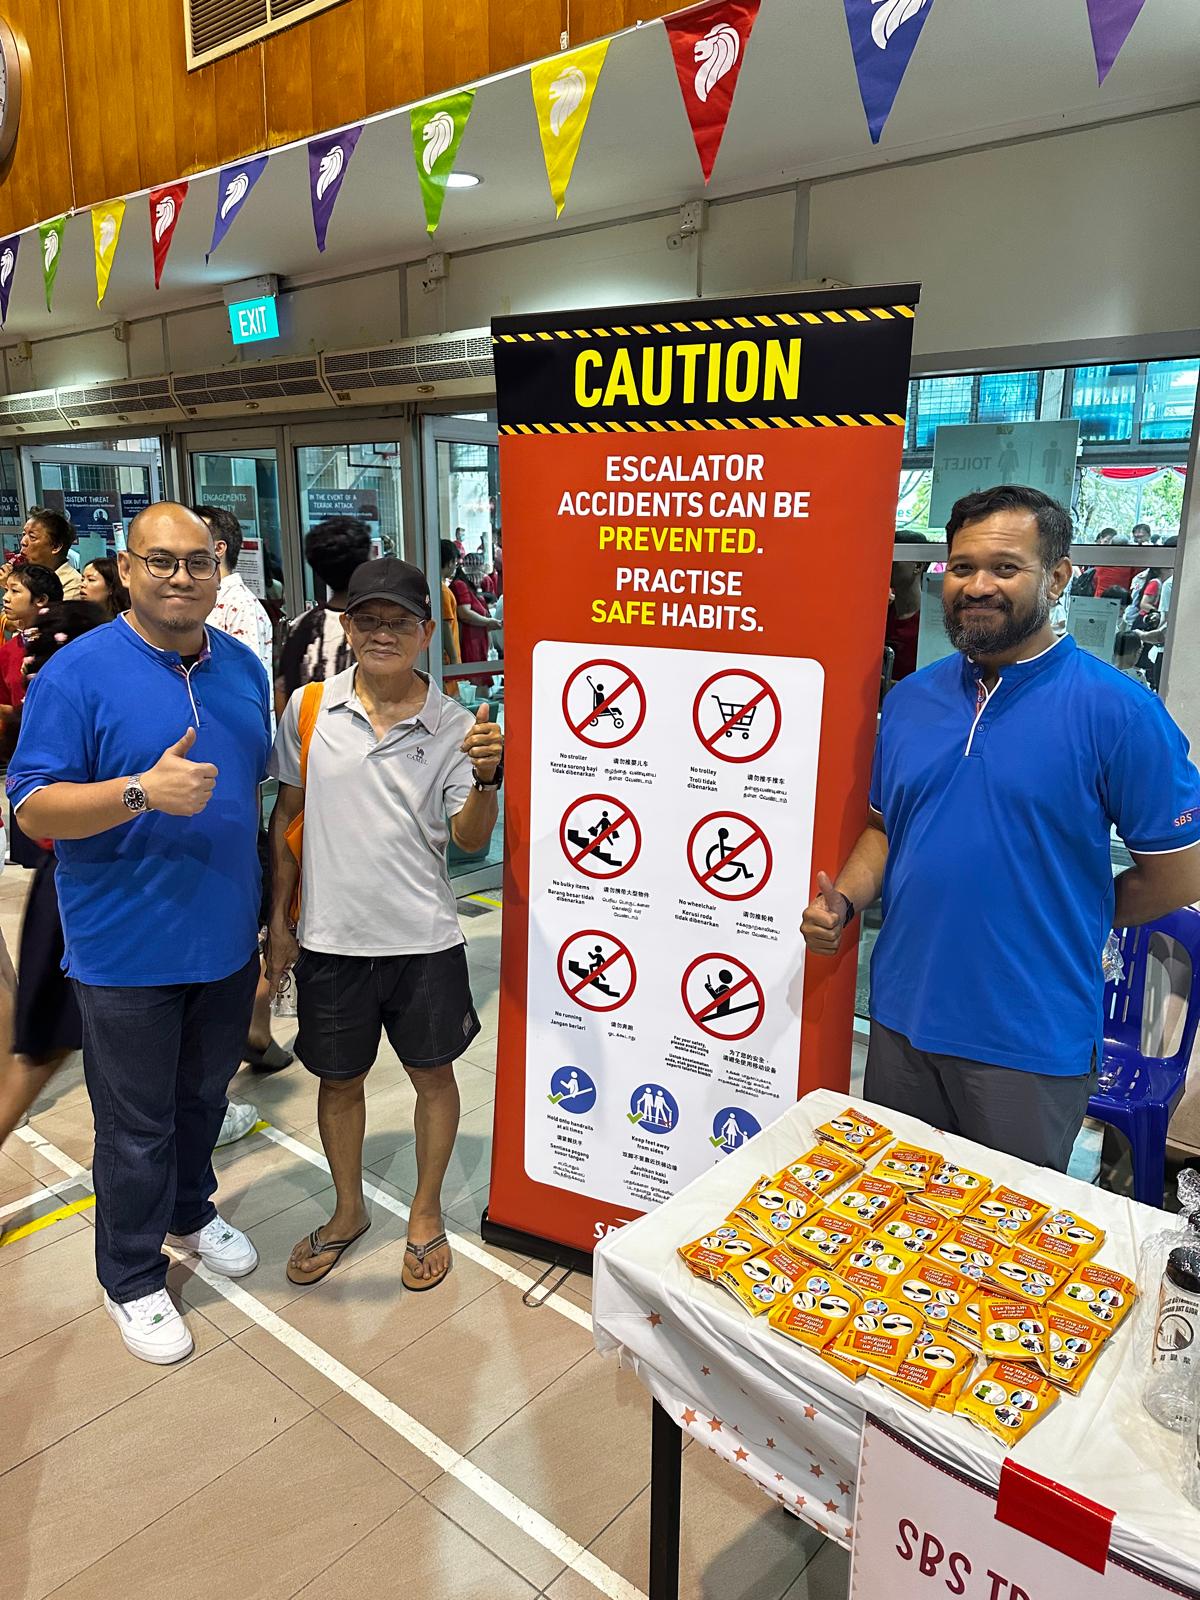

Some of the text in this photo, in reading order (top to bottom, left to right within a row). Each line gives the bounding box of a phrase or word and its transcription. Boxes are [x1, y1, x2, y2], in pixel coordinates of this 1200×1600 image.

[238, 306, 267, 337] EXIT
[574, 338, 802, 408] CAUTION
[605, 453, 765, 482] ESCALATOR
[557, 491, 811, 518] ACCIDENTS CAN BE
[599, 526, 765, 555] PREVENTED.
[615, 567, 743, 597] PRACTISE
[591, 599, 765, 633] SAFE HABITS.
[699, 768, 717, 776] trolley
[687, 783, 717, 792] dibenarkan
[1174, 813, 1193, 827] SBS
[561, 881, 574, 889] bulky
[548, 889, 565, 897] Barang
[688, 901, 716, 910] wheelchair
[682, 910, 699, 918] Kerusi
[551, 1019, 568, 1027] Jangan
[563, 1013, 582, 1021] running
[1002, 1364, 1040, 1381] Use the Lift
[895, 1518, 972, 1595] SBS
